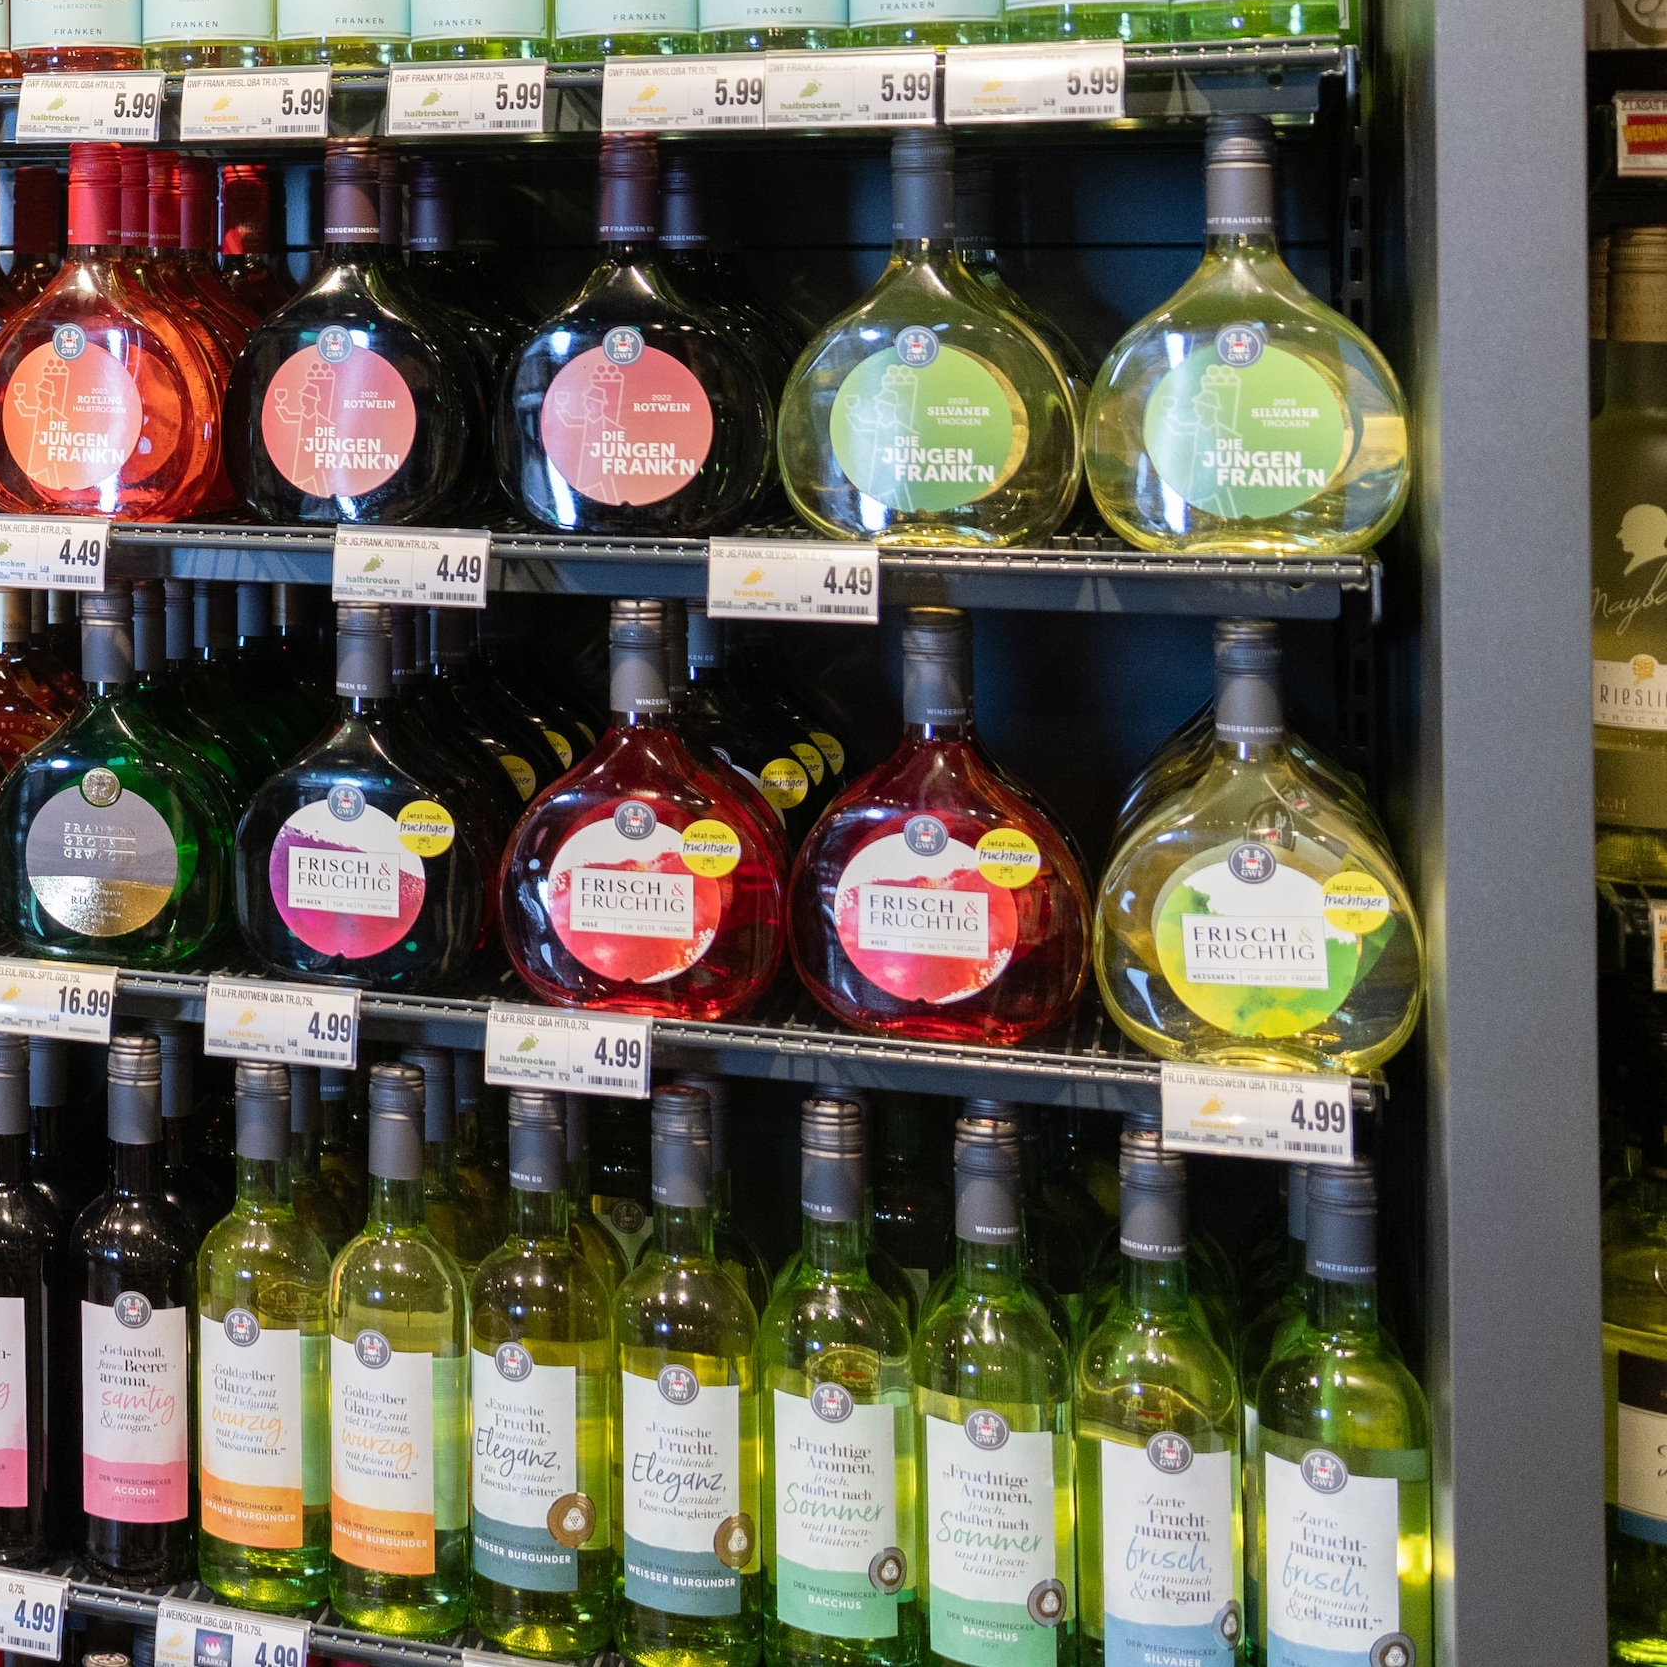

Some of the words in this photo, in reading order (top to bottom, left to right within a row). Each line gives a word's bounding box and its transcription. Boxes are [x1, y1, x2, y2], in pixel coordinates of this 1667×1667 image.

[54, 27, 103, 36] FRANKEN
[881, 72, 931, 102] 5.99
[1067, 66, 1120, 95] 5.99
[282, 88, 324, 116] 5.99
[496, 84, 542, 110] 5.99
[715, 78, 762, 107] 5.99
[114, 93, 156, 118] 5.99
[404, 109, 459, 118] halbtrocken
[344, 399, 396, 411] ROTWEIN
[1250, 407, 1319, 419] SILVANER
[49, 422, 69, 433] DIE
[315, 426, 335, 439] DIE
[602, 430, 627, 442] DIE
[40, 431, 108, 448] JUNGEN
[305, 439, 380, 455] JUNGEN
[895, 435, 919, 448] DIE
[1215, 439, 1243, 451] DIE
[48, 447, 124, 465] FRANK'N
[590, 442, 675, 459] JUNGEN
[882, 447, 973, 466] JUNGEN
[1203, 450, 1301, 470] JUNGEN
[315, 453, 398, 471] FRANK'N
[601, 457, 696, 477] FRANK'N
[895, 462, 995, 483] FRANK'N
[1217, 467, 1325, 487] FRANK'N
[59, 539, 100, 566] 4.49
[437, 555, 481, 583] 4.49
[346, 575, 400, 585] halbtrocken
[823, 565, 872, 597] 4.49
[297, 857, 372, 877] FRISCH
[378, 861, 391, 876] &
[297, 873, 391, 891] FRUCHTIG
[581, 877, 665, 896] FRISCH
[671, 881, 684, 896] &
[581, 893, 686, 914] FRUCHTIG
[869, 894, 958, 915] FRISCH
[964, 898, 978, 915] &
[869, 910, 978, 932] FRUCHTIG
[1193, 925, 1287, 944] FRISCH
[1297, 927, 1314, 944] &
[1195, 941, 1315, 961] FRUCHTIG
[59, 986, 109, 1017] 16.99
[308, 1011, 351, 1042] 4.99
[500, 1054, 556, 1066] halbtrocken
[595, 1036, 641, 1068] 4.99
[1291, 1098, 1345, 1132] 4.99
[114, 1486, 156, 1496] ACOLON
[336, 1524, 363, 1543] GRAUER
[366, 1532, 429, 1548] BURGUNDER
[628, 1564, 668, 1584] WEISSER
[672, 1576, 736, 1589] BURGUNDER
[808, 1594, 862, 1610] BACCHUS
[14, 1600, 55, 1633] 4.99
